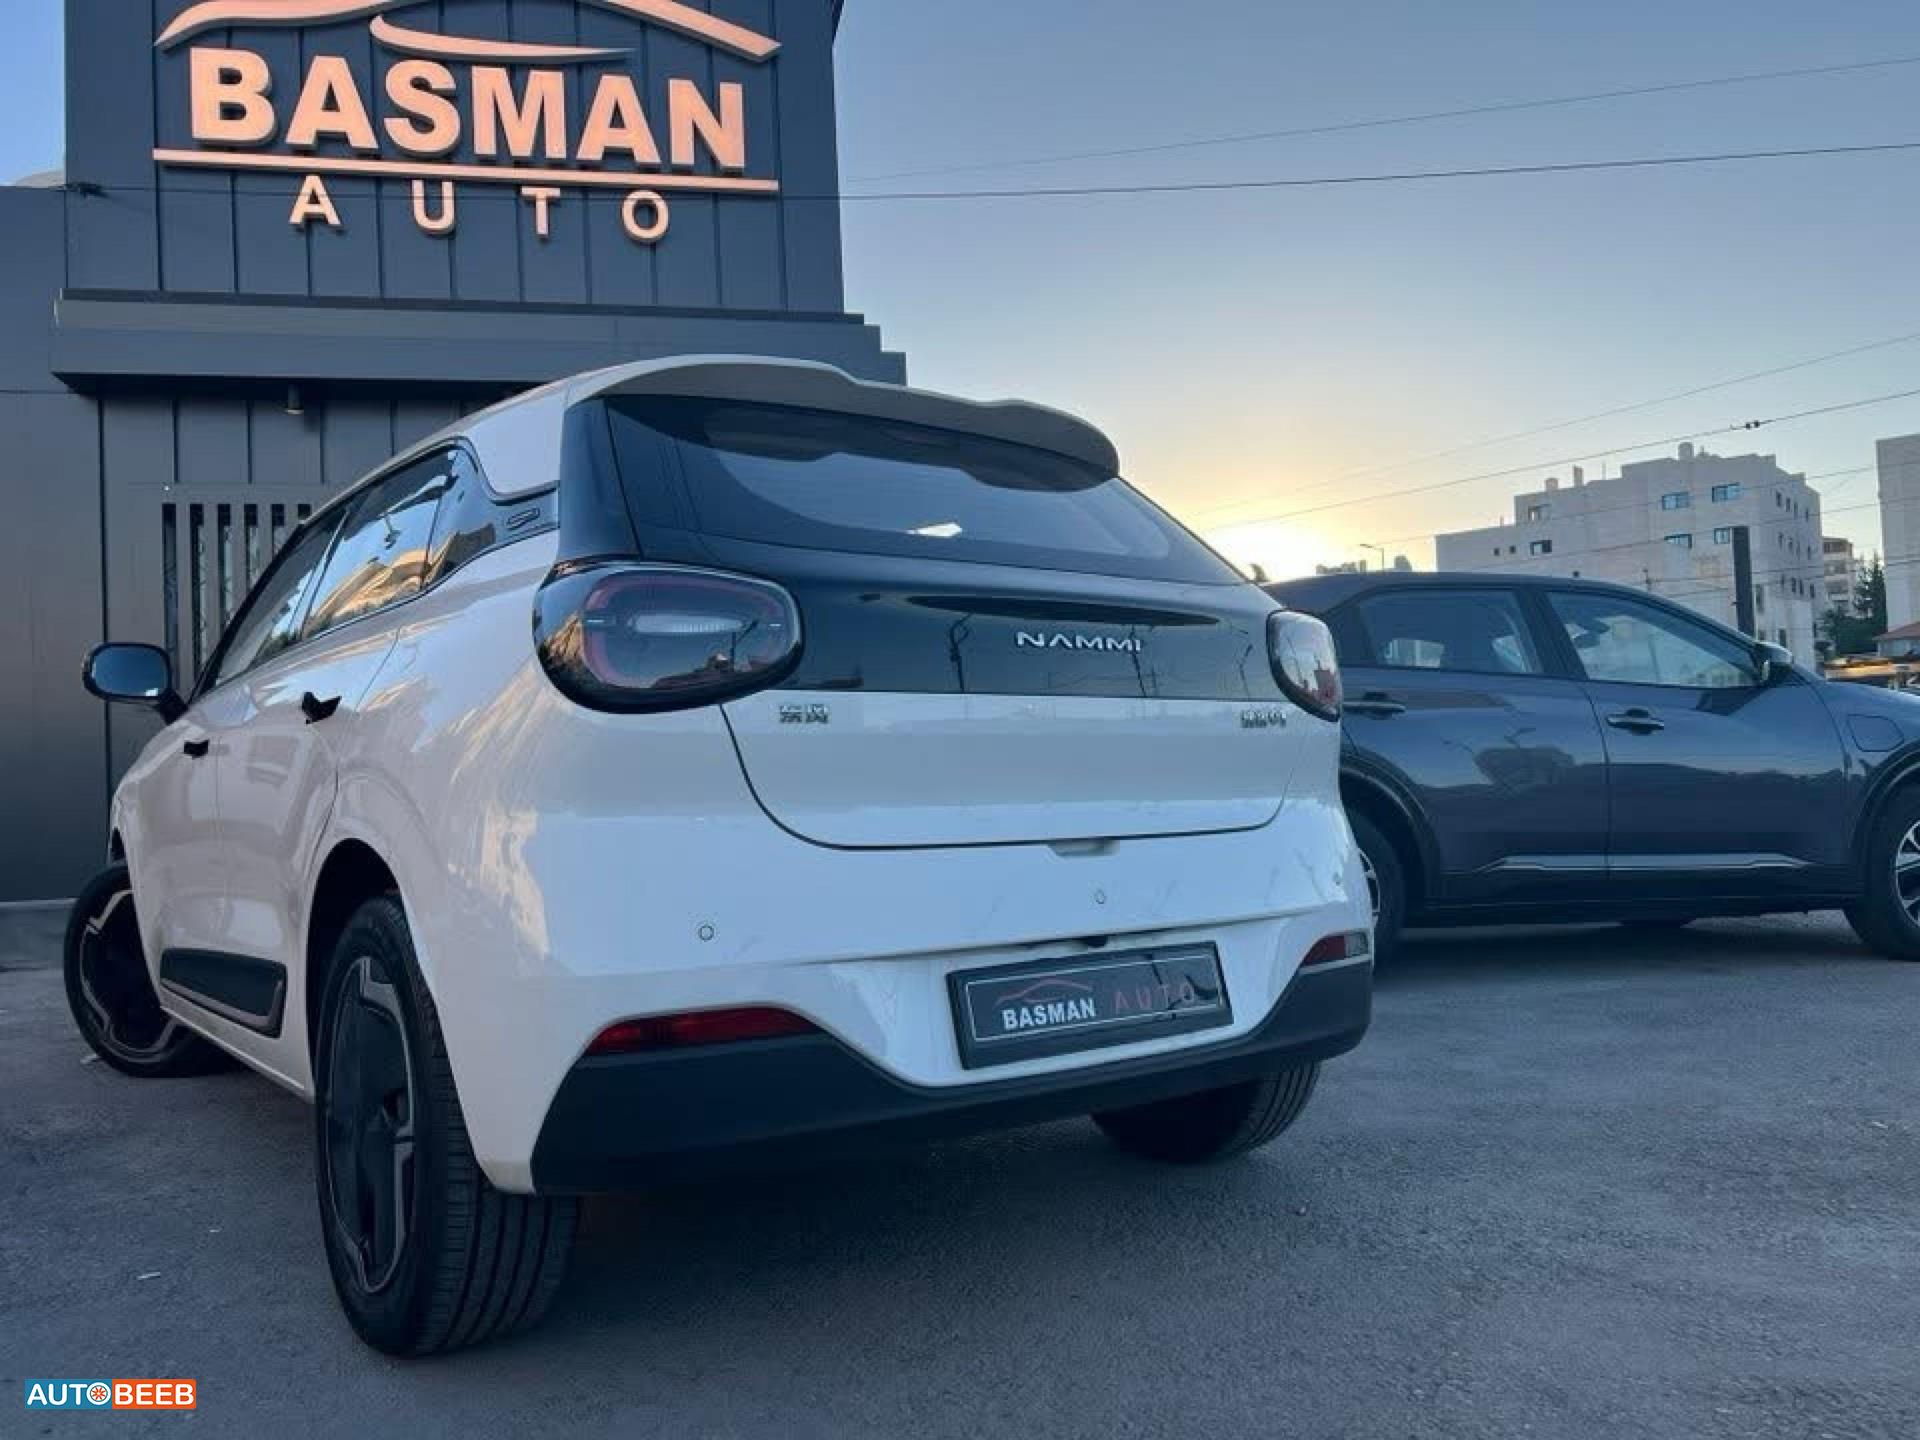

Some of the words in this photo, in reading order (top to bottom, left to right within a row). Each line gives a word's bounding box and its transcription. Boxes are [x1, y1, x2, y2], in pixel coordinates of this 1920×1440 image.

[189, 46, 746, 172] BASMAN
[288, 174, 670, 241] AUTO
[1016, 631, 1141, 651] NAMMI
[1001, 998, 1096, 1031] BASMAN
[1114, 982, 1195, 1015] AUTO
